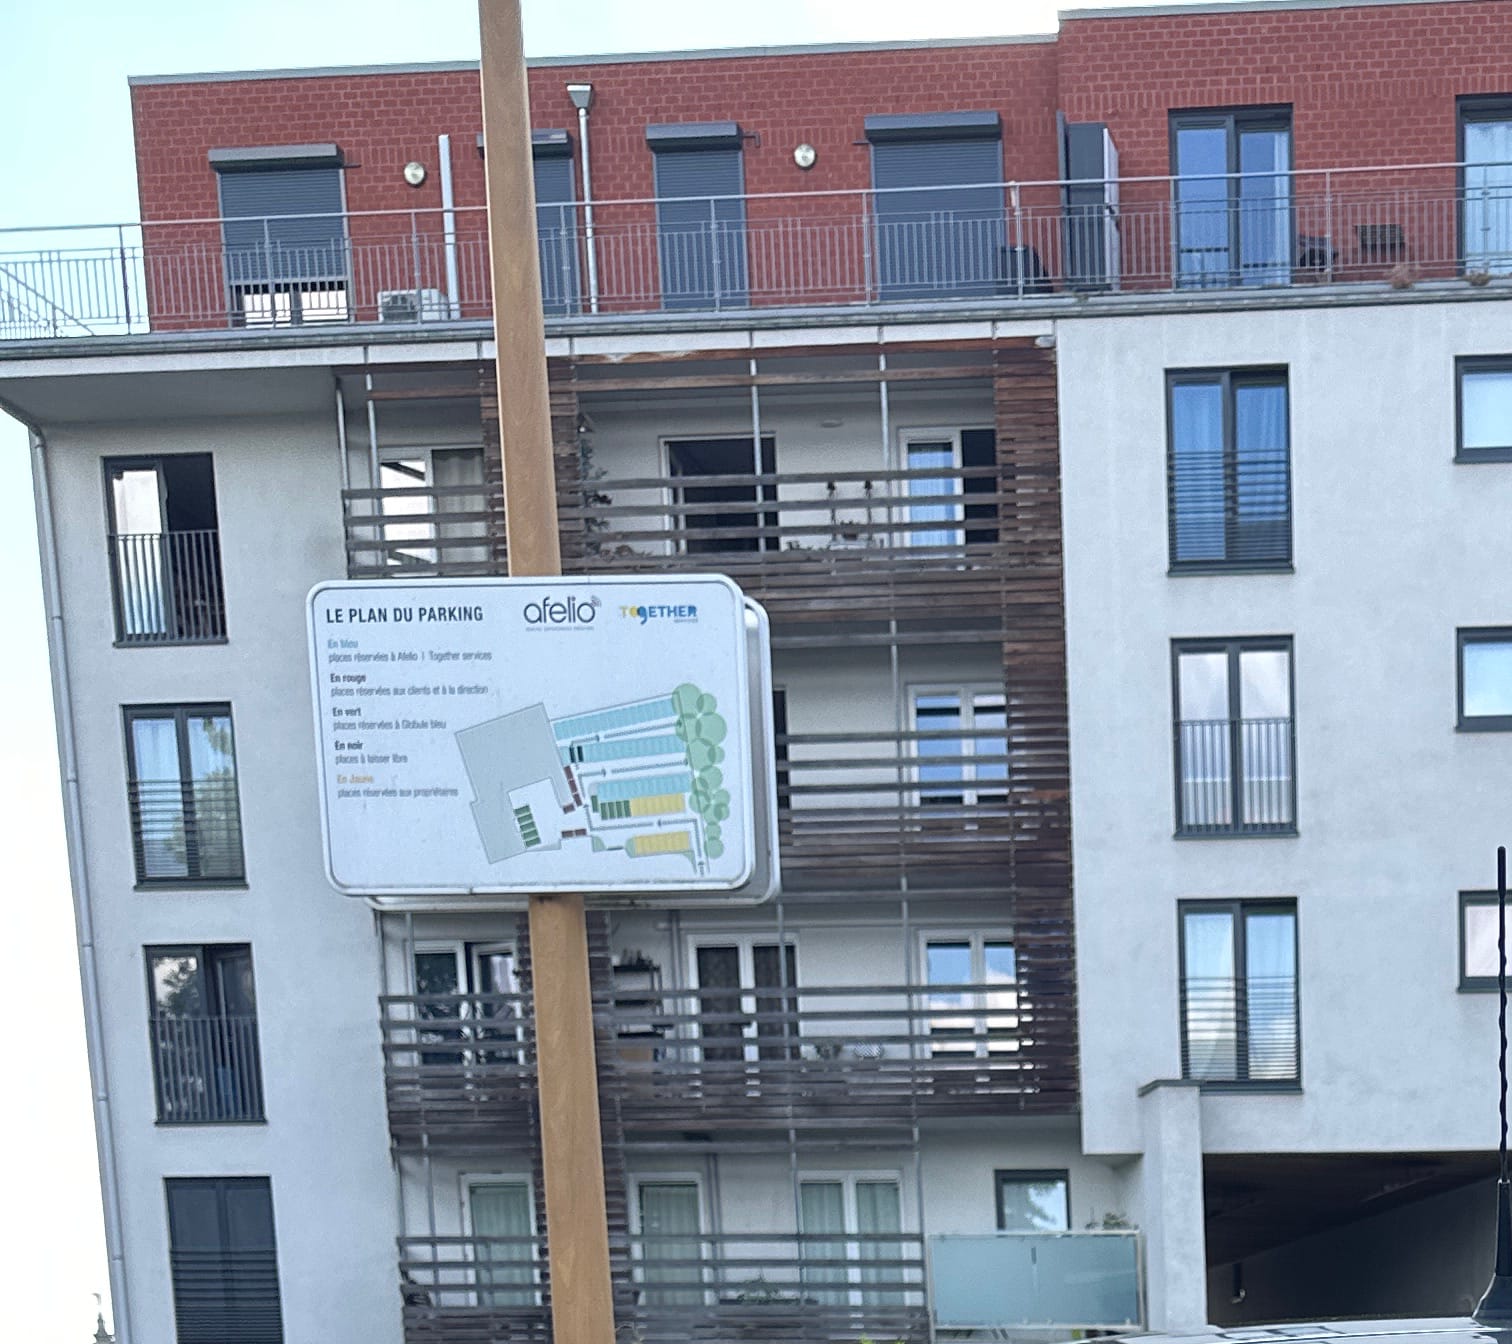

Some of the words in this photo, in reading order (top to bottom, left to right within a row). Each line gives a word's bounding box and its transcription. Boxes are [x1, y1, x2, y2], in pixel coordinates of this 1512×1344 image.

[326, 608, 344, 623] LE
[349, 607, 387, 623] PLAN
[393, 607, 412, 622] DU
[418, 606, 484, 622] PARKING
[523, 596, 596, 624] afelio
